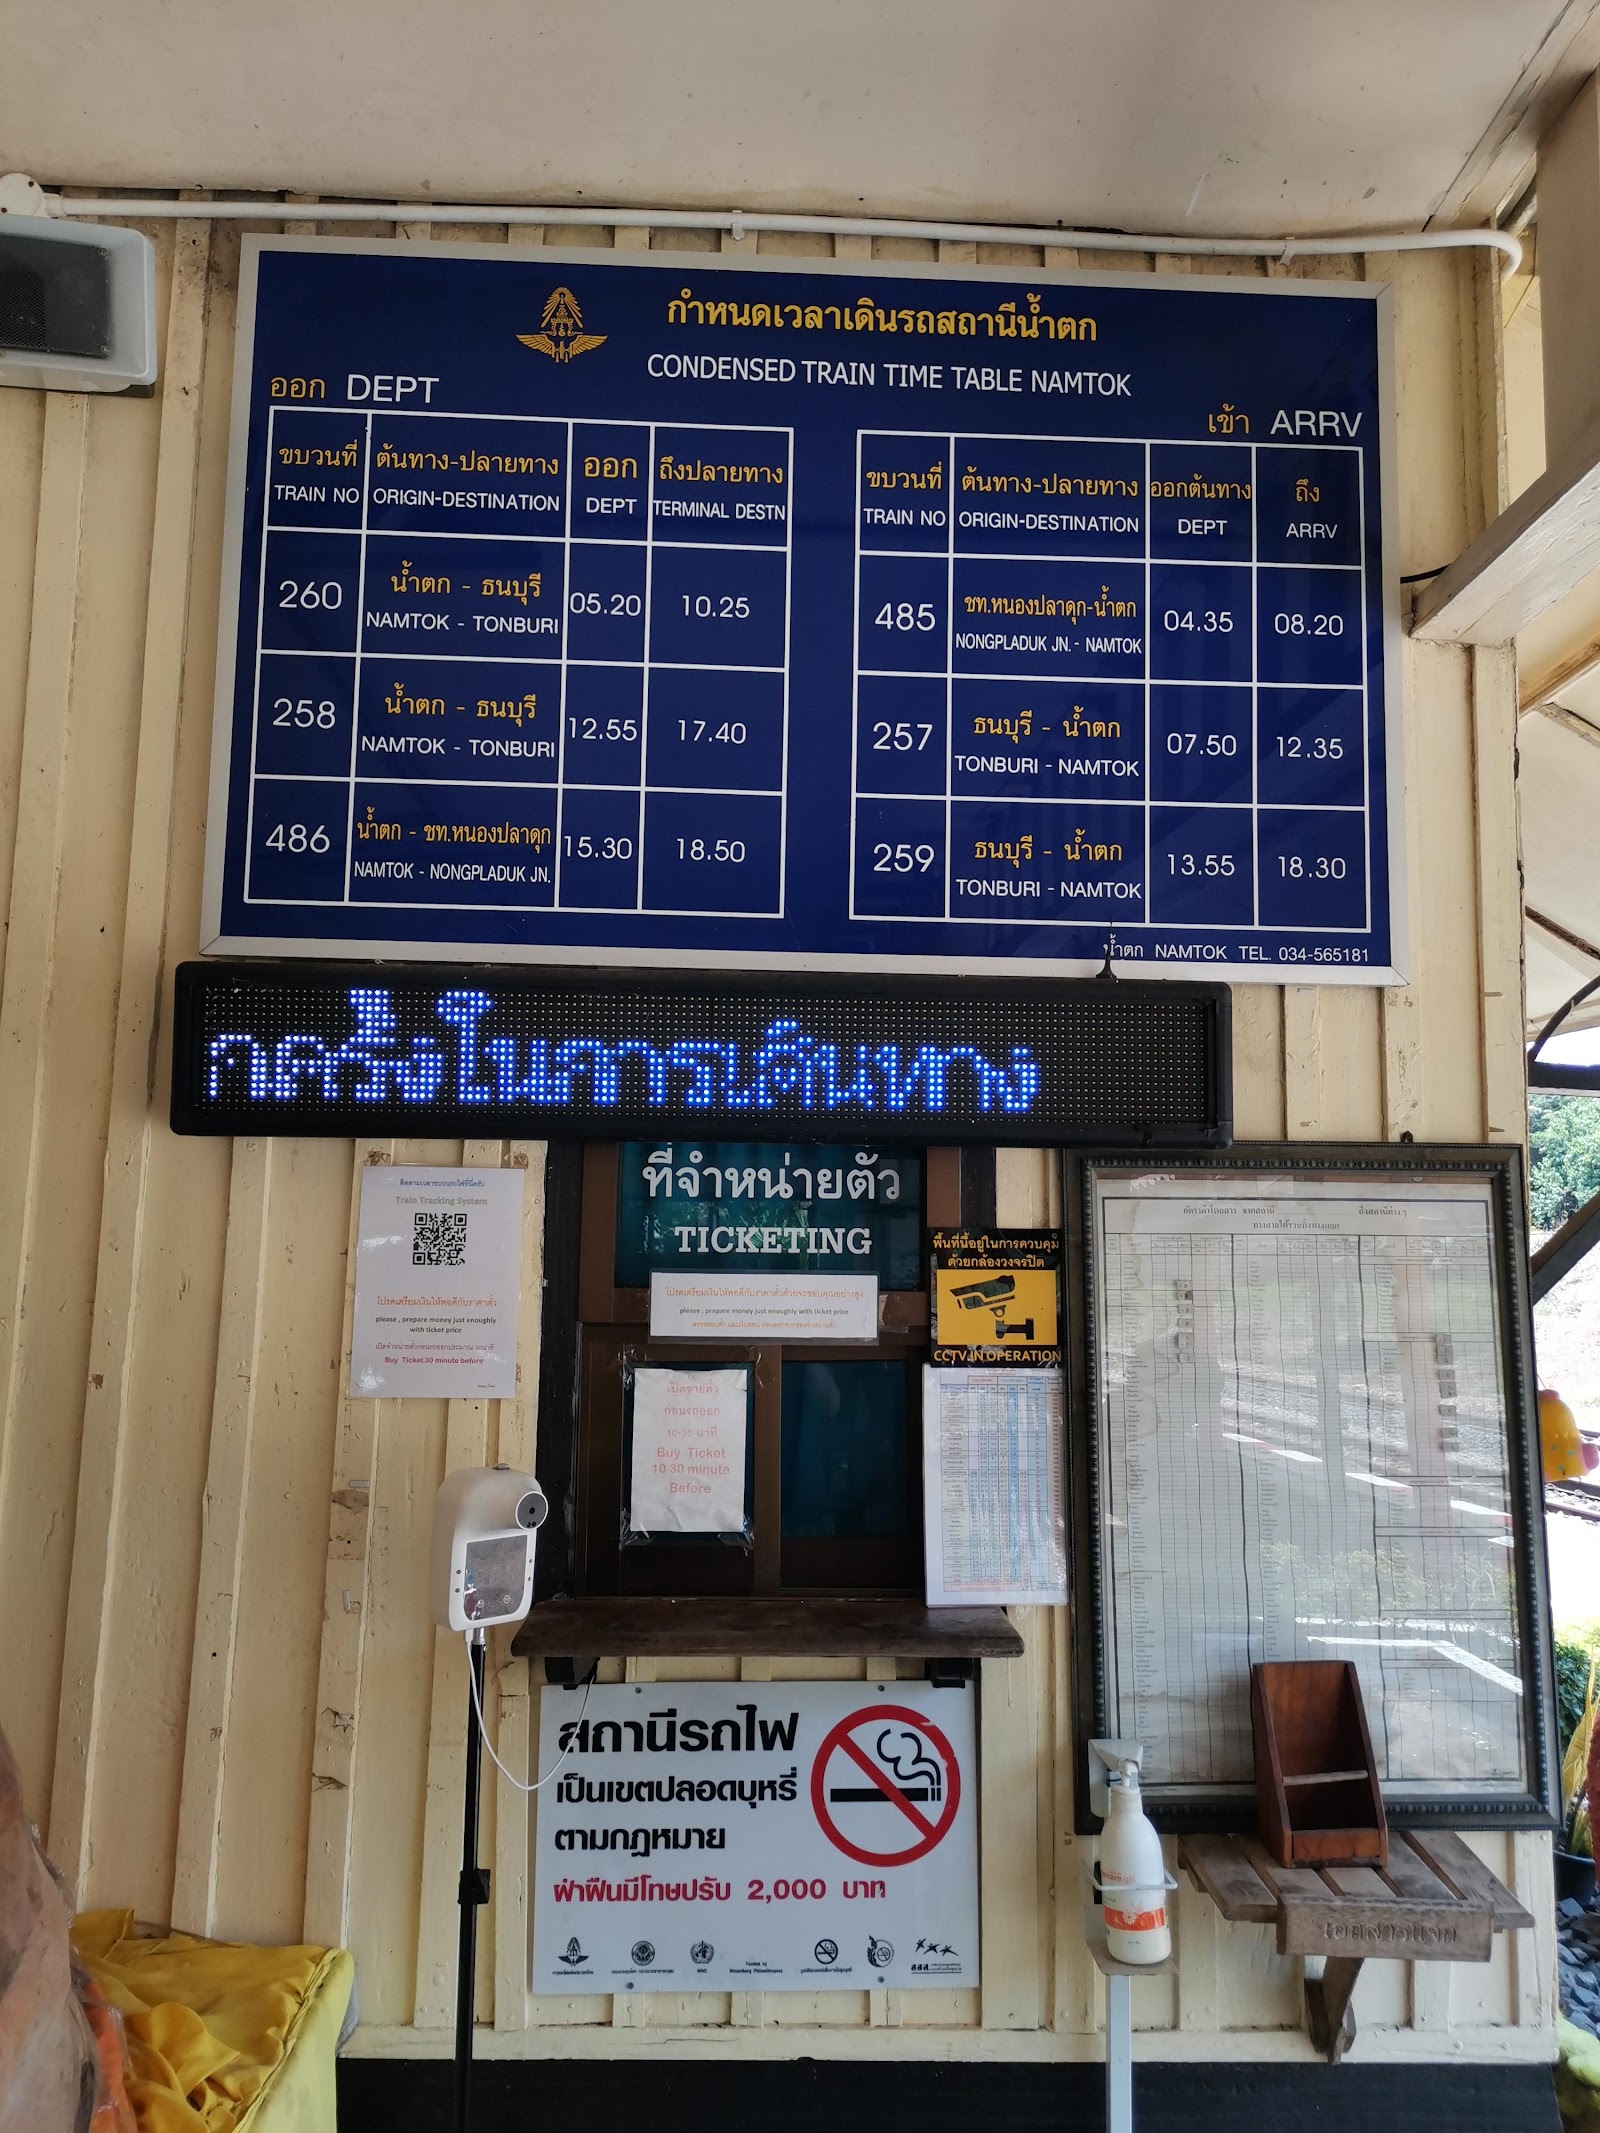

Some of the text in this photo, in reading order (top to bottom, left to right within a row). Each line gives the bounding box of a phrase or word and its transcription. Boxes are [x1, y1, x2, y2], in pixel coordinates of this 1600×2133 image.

[667, 286, 1098, 342] กำหนดเวลาเดินรถสถานีน้ำตก
[647, 353, 1132, 397] CONDENSED TRAIN TIME TABLE NAMTOK
[271, 373, 440, 404] ออก DEPT
[1207, 408, 1363, 437] เข้า ARRV
[278, 439, 358, 467] ขบวนที่
[376, 442, 559, 475] ต้นทาง-ปลายทาง
[584, 456, 637, 479] ออก
[659, 455, 783, 484] ถึงปลายทาง
[866, 465, 942, 490] ขบวนที่
[961, 465, 1138, 497] ต้นทาง-ปลายทาง
[1150, 473, 1251, 500] ออกต้นทาง
[1295, 478, 1320, 502] ถึง
[274, 484, 360, 504] TRAIN NO
[372, 487, 560, 512] ORIGIN-DESTINATION
[586, 497, 638, 515] DEPT
[653, 499, 786, 521] TERMINAL DESTN
[863, 507, 946, 527] TRAIN NO
[958, 511, 1139, 533] ORIGIN-DESTINATION
[1178, 518, 1228, 536] DEPT
[1285, 522, 1338, 539] ARRV
[279, 580, 342, 610] 260
[390, 560, 451, 594] น้ำตก
[481, 572, 542, 606] ธนบุรี
[569, 592, 642, 617] 05.20
[682, 594, 750, 619] 10.25
[366, 611, 450, 631] NAMTOK
[472, 615, 559, 634] TONBURI
[874, 602, 936, 632] 485
[1164, 609, 1234, 633] 04.35
[1274, 613, 1344, 636] 08.20
[955, 632, 1048, 652] NONGPLADUK
[1051, 636, 1072, 653] JN.
[1085, 636, 1142, 654] NAMTOK
[272, 698, 336, 729] 258
[384, 682, 445, 716] น้ำตก
[476, 693, 537, 728] ธนบุรี
[568, 717, 638, 742] 12.55
[678, 719, 747, 745] 17.40
[873, 721, 933, 751] 257
[973, 709, 1033, 744] ธนบุรี
[1062, 705, 1121, 738] น้ำตก
[361, 735, 446, 755] NAMTOK
[468, 739, 555, 758] TONBURI
[1167, 732, 1237, 756] 07.50
[1276, 736, 1344, 760] 12.35
[954, 755, 1039, 774] TONBURI
[1058, 758, 1140, 777] NAMTOK
[357, 806, 401, 840] น้ำตก
[265, 824, 330, 854] 486
[564, 835, 633, 860] 15.30
[676, 838, 746, 863] 18.50
[974, 834, 1033, 869] ธนบุรี
[1064, 828, 1122, 861] น้ำตก
[873, 843, 935, 873] 259
[1167, 853, 1235, 877] 13.55
[1278, 856, 1346, 879] 18.30
[354, 861, 414, 879] NAMTOK
[430, 863, 526, 883] NONGPLADUK
[529, 866, 551, 884] JN.
[955, 878, 1041, 898] TONBURI
[1060, 881, 1142, 899] NAMTOK
[1155, 943, 1228, 960] NAMTOK
[1238, 945, 1272, 961] TEL.
[1278, 946, 1368, 963] 034-565181
[394, 1195, 488, 1207] Train Tracking System
[674, 1225, 873, 1255] TICKETING
[932, 1231, 1060, 1253] พื้นที่นี้อยู่ในการควบคุม
[947, 1253, 1045, 1268] ด้วยกล้องวงจรปิด
[375, 1316, 397, 1324] please
[401, 1317, 428, 1325] prepare
[428, 1317, 452, 1325] money
[452, 1316, 465, 1325] just
[466, 1316, 497, 1325] enoughly
[679, 1307, 700, 1315] please
[705, 1307, 731, 1316] prepare
[731, 1308, 753, 1316] money
[754, 1307, 767, 1316] just
[768, 1307, 798, 1316] enoughly
[799, 1307, 813, 1315] with
[814, 1307, 832, 1315] ticket
[833, 1308, 849, 1316] price
[384, 1356, 399, 1365] Buy
[401, 1356, 424, 1364] Ticket
[933, 1349, 1062, 1362] CCTV IN OPERATION
[656, 1446, 726, 1460] Buy Ticket
[687, 1463, 730, 1476] minute
[669, 1482, 712, 1494] Before
[558, 1703, 800, 1753] สถานีรถไฟ
[556, 1766, 798, 1809] เป็นเขตปลอดบุหรี่
[553, 1874, 886, 1904] ฝ่าฝืนมีโทษปรับ 2,000 บาท
